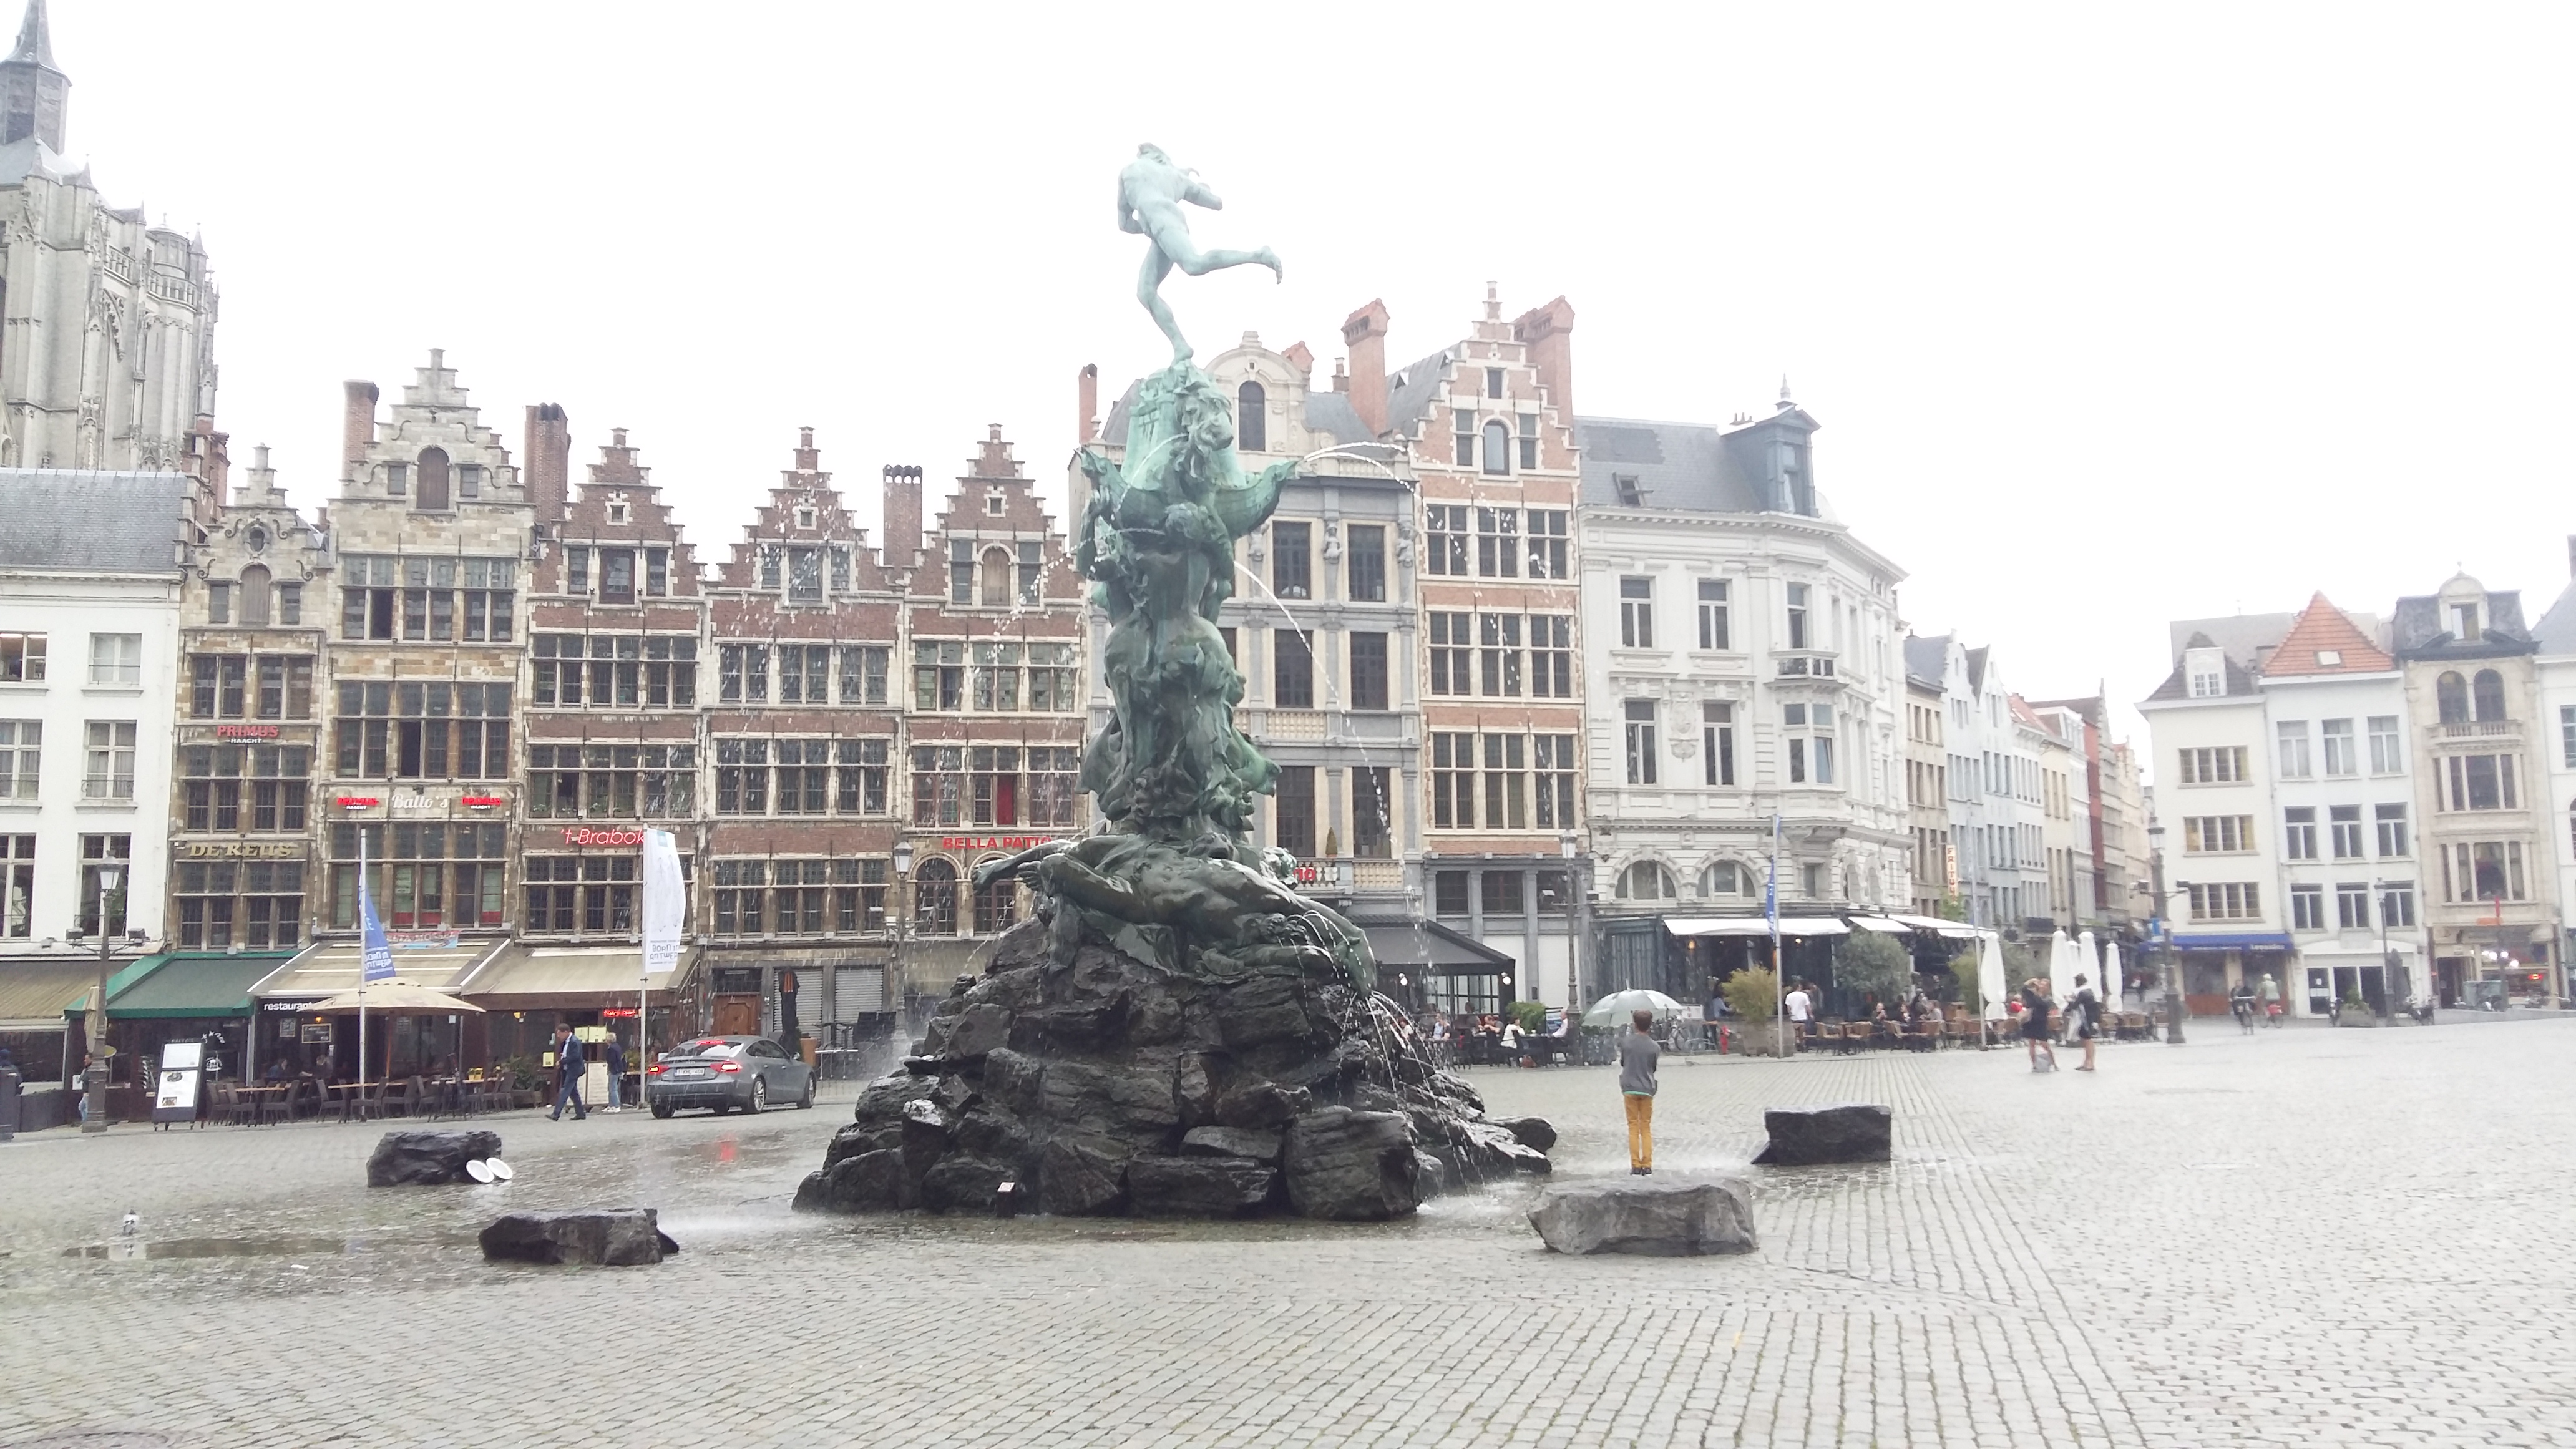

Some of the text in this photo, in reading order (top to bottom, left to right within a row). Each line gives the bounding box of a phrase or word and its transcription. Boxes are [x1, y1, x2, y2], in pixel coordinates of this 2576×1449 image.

[217, 725, 279, 738] PRIMUS
[561, 829, 573, 844] 't
[942, 836, 998, 849] BELLA
[189, 843, 220, 857] DE
[652, 944, 671, 952] BORN
